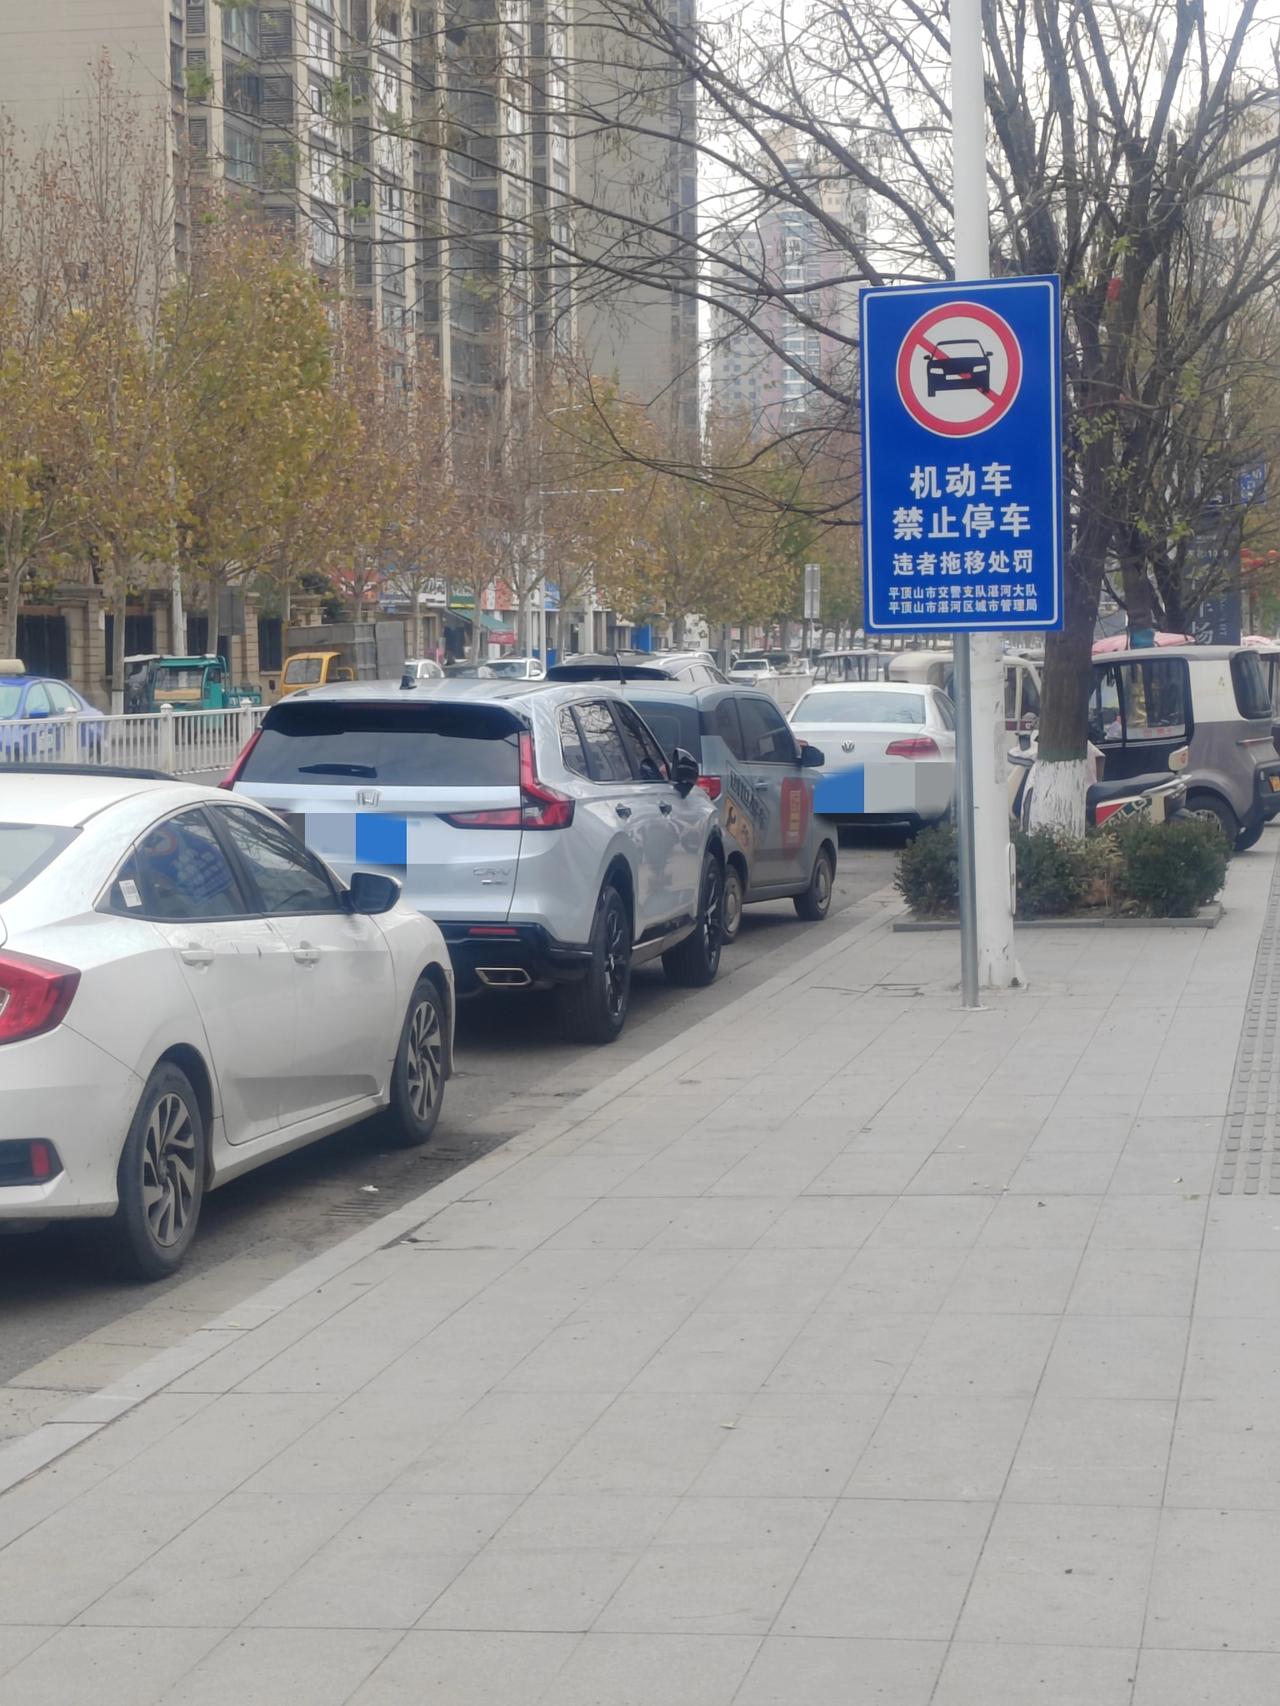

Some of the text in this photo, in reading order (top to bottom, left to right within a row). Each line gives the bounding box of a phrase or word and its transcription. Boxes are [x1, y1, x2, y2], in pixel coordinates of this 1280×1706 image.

[909, 462, 1012, 500] 机动车
[892, 503, 1031, 541] 禁止停车
[892, 549, 1033, 576] 违者拖移处罚
[888, 583, 1037, 600] 平顶山市交警支队湛河大队
[888, 598, 1037, 615] 平顶山市湛河区城市管理局
